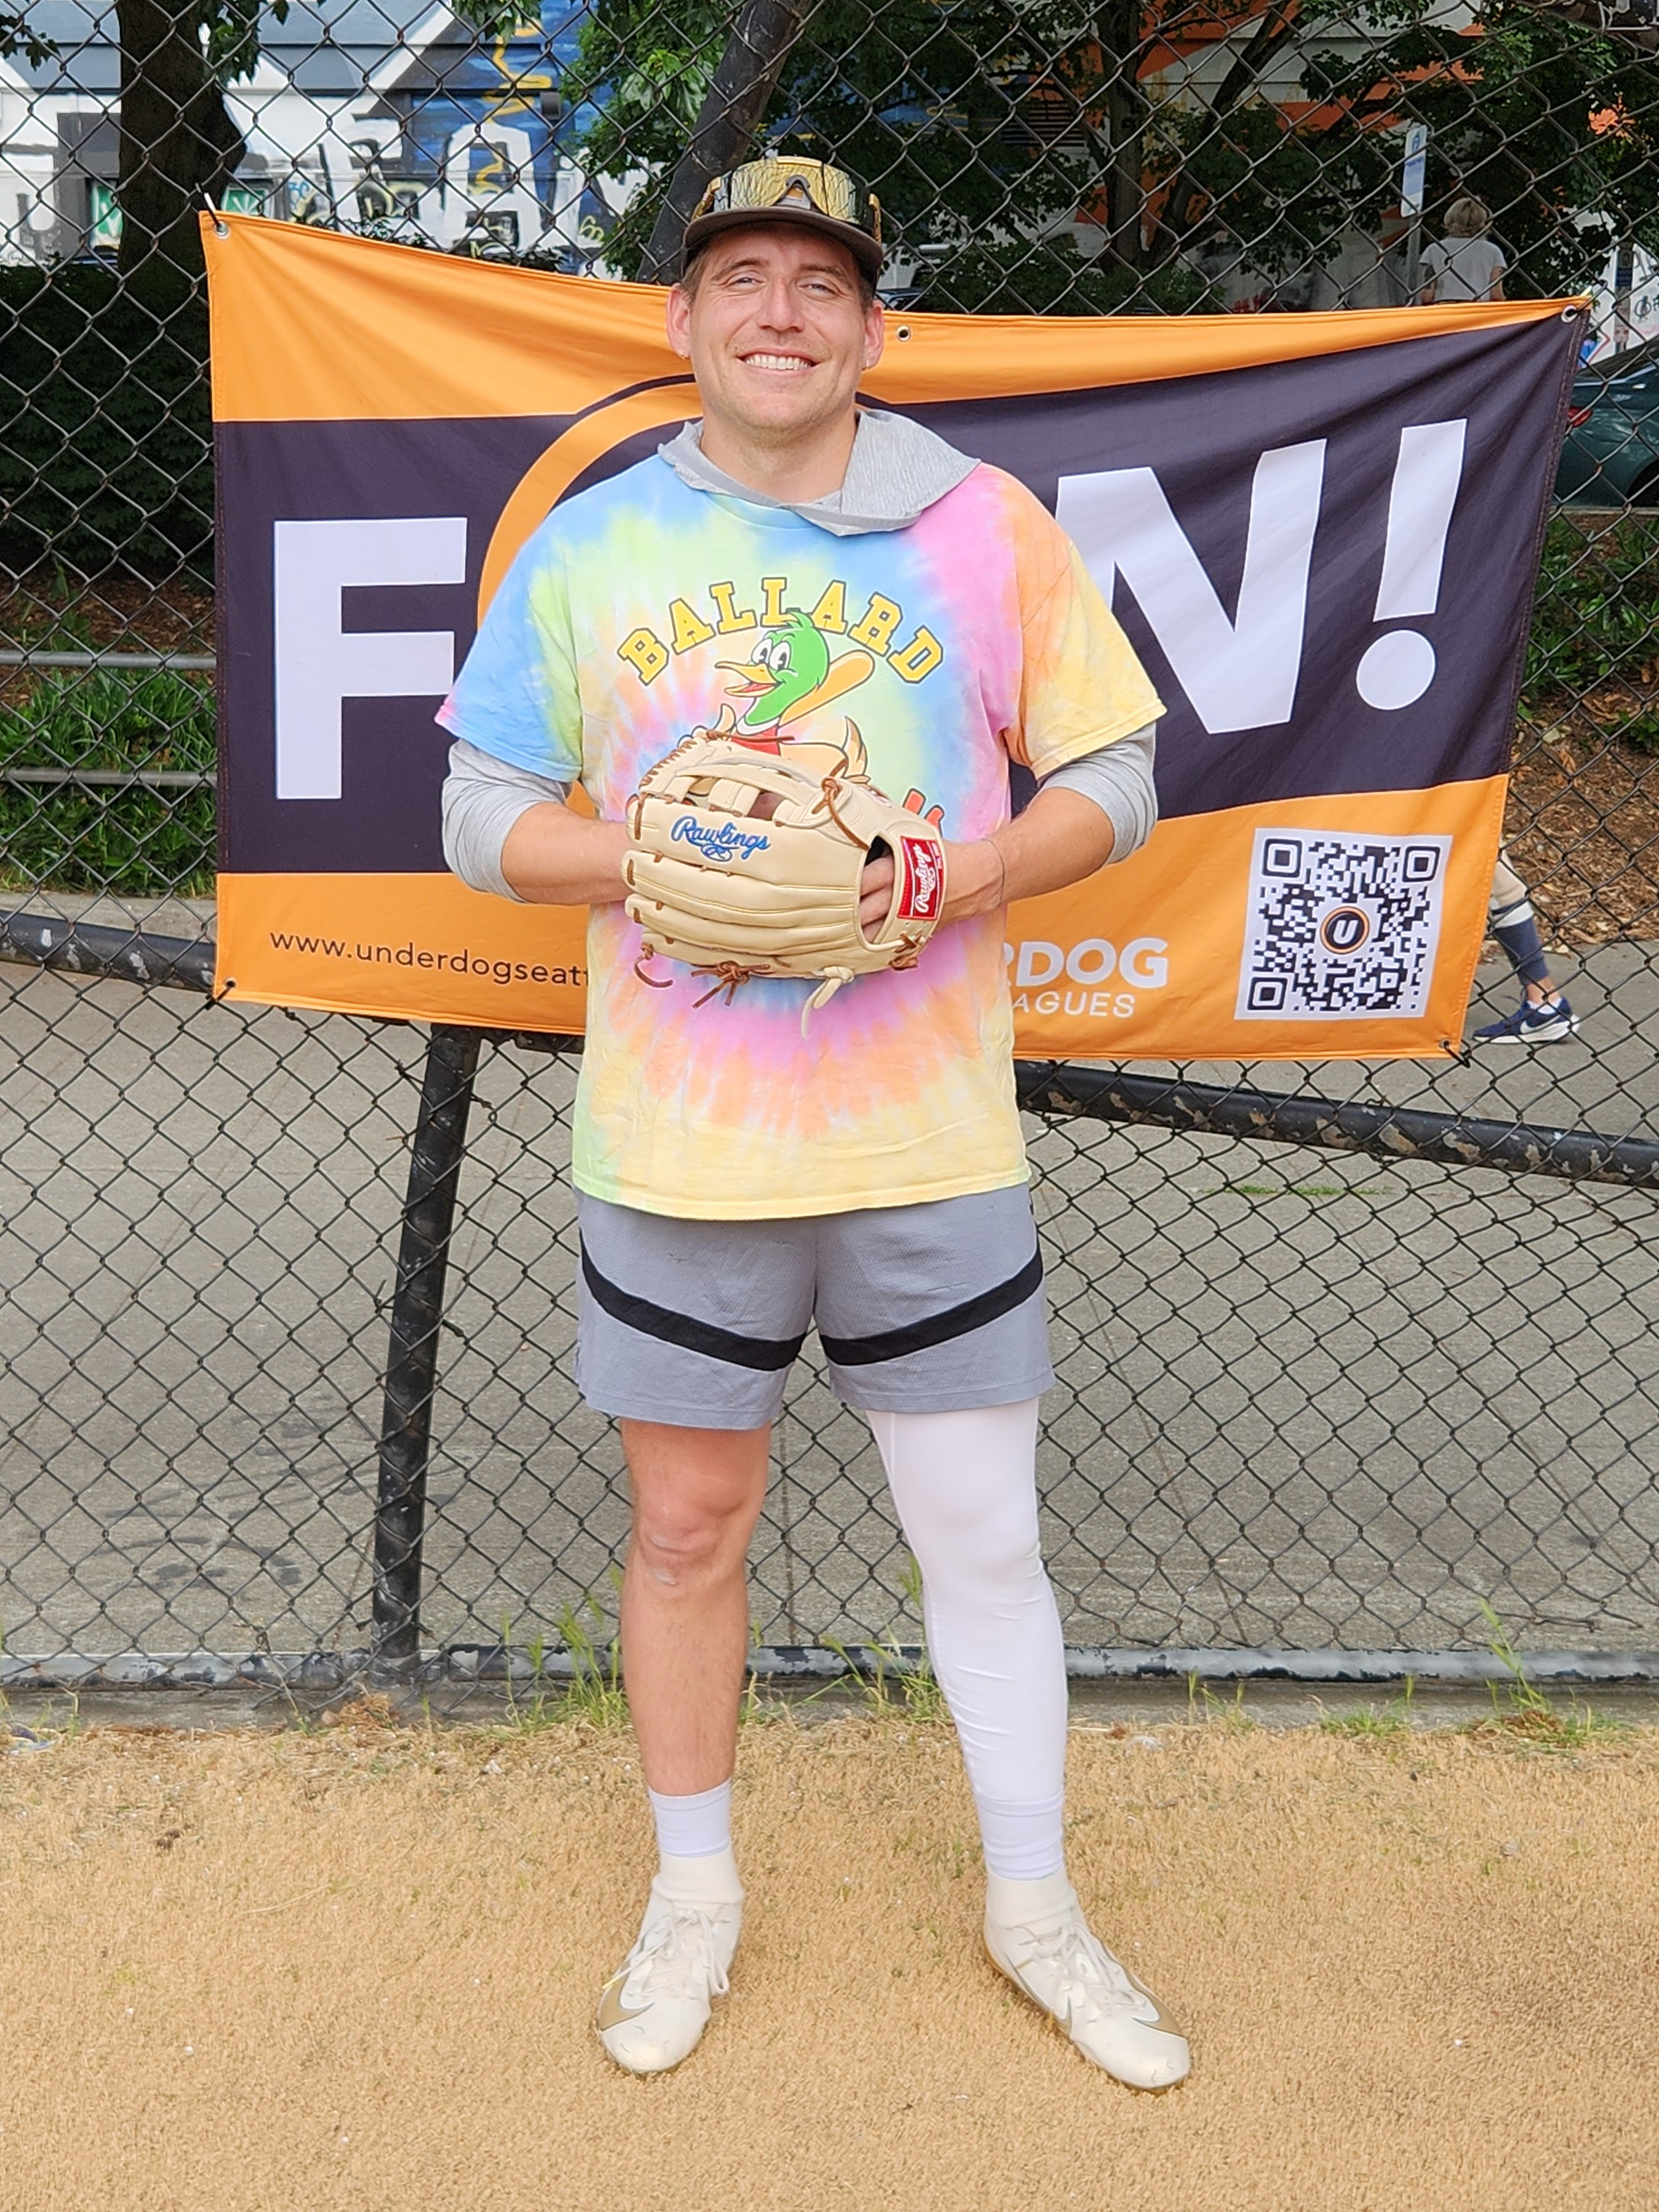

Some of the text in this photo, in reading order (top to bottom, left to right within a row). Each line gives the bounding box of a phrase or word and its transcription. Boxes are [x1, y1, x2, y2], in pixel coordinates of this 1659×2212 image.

[274, 418, 1467, 800] FN!
[617, 577, 944, 686] BALLARD
[670, 814, 772, 861] Rawlings
[913, 843, 933, 913] Rawlings
[1333, 919, 1359, 945] U
